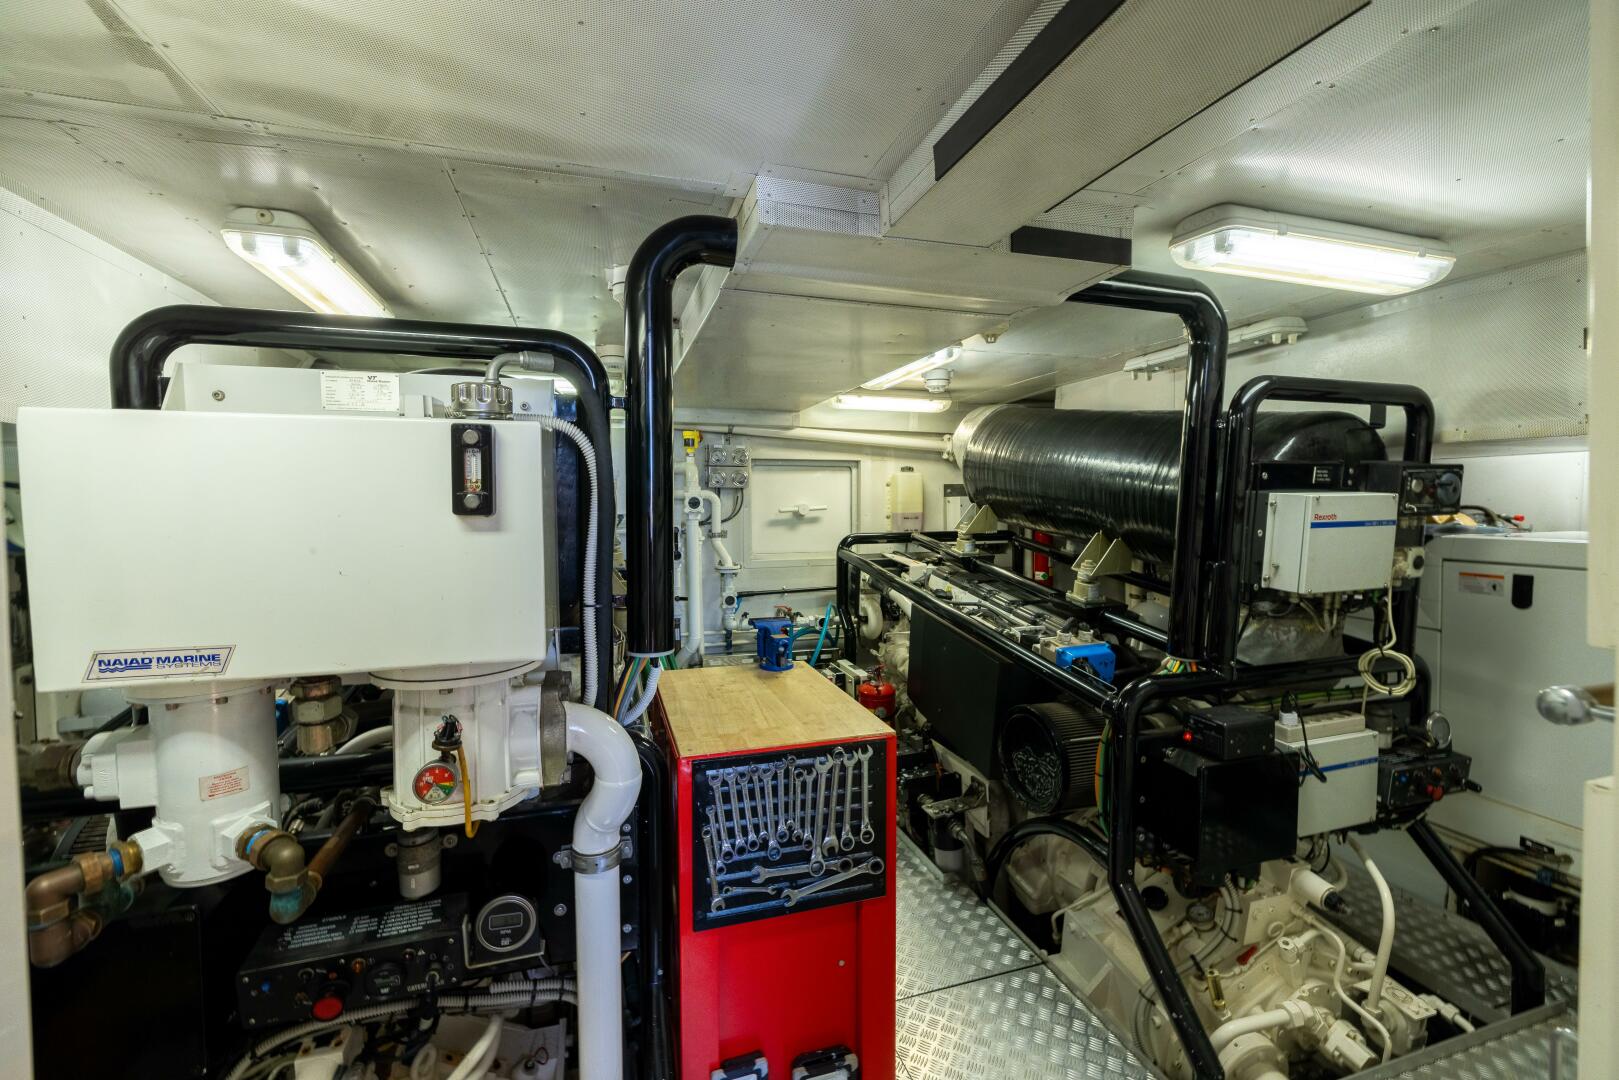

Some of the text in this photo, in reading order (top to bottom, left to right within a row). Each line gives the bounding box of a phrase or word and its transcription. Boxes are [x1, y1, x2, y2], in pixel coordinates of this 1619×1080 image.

[1314, 513, 1337, 521] Rexroth
[97, 654, 221, 667] NAIAD MARINE
[156, 661, 222, 670] SYSTEMS
